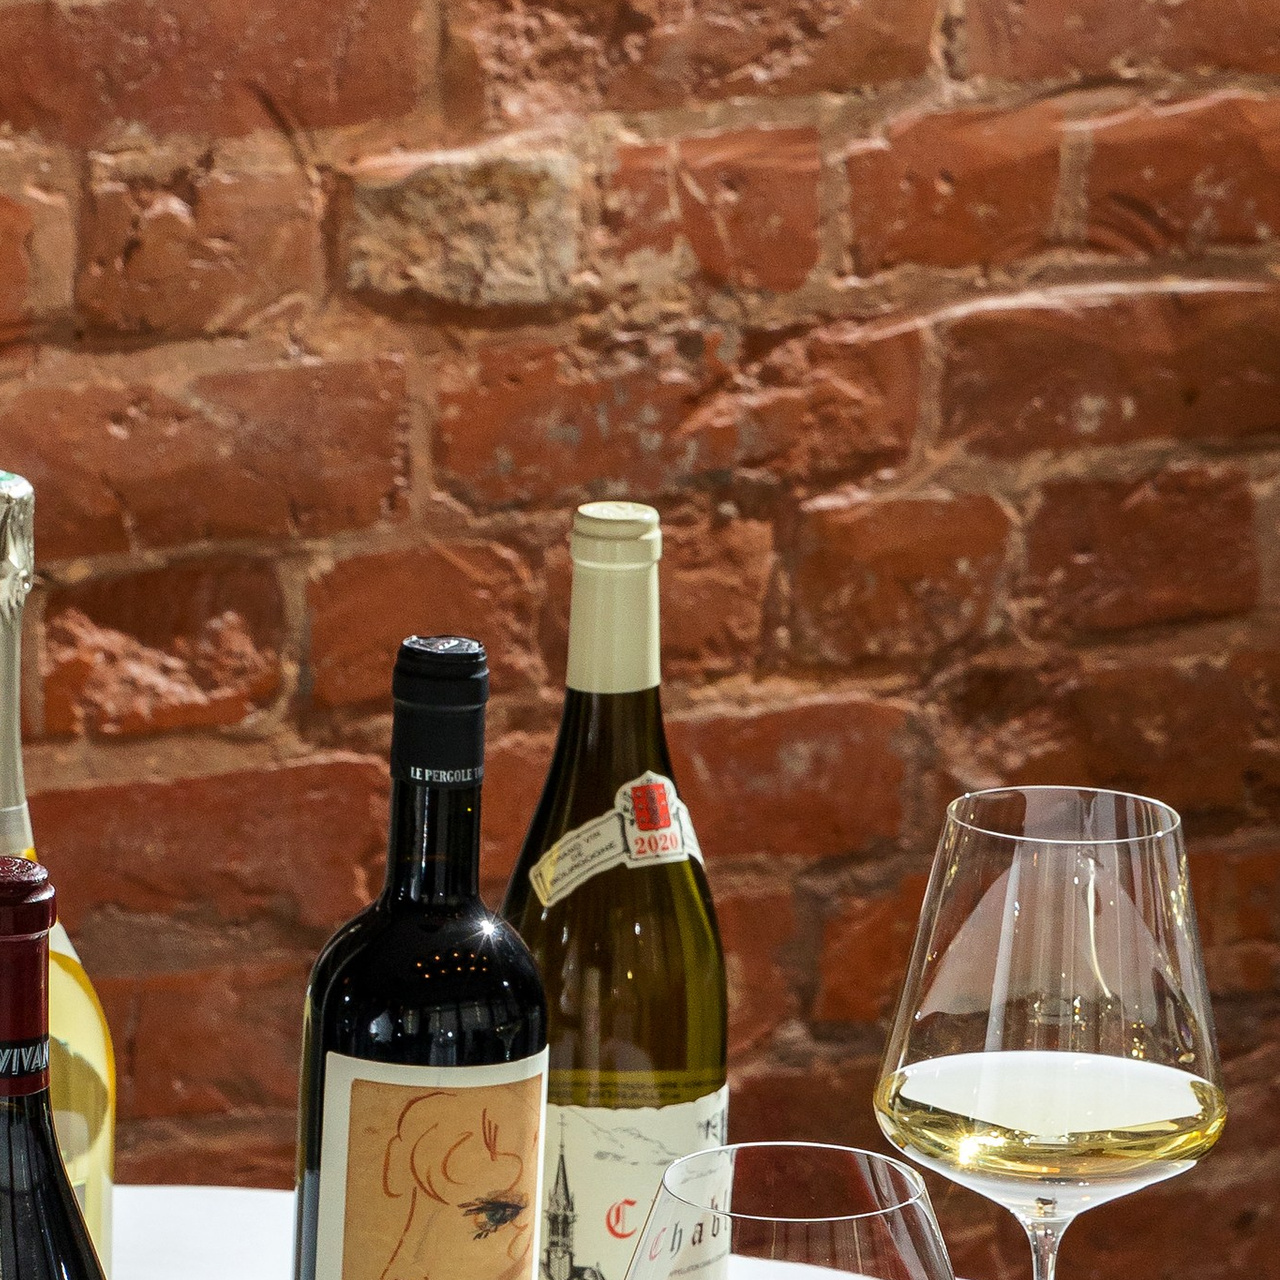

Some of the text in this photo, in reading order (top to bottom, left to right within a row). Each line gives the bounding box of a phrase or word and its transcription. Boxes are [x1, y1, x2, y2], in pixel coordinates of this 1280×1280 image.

[410, 766, 423, 780] LE
[424, 768, 472, 783] PERGOLE
[634, 833, 678, 856] 2020
